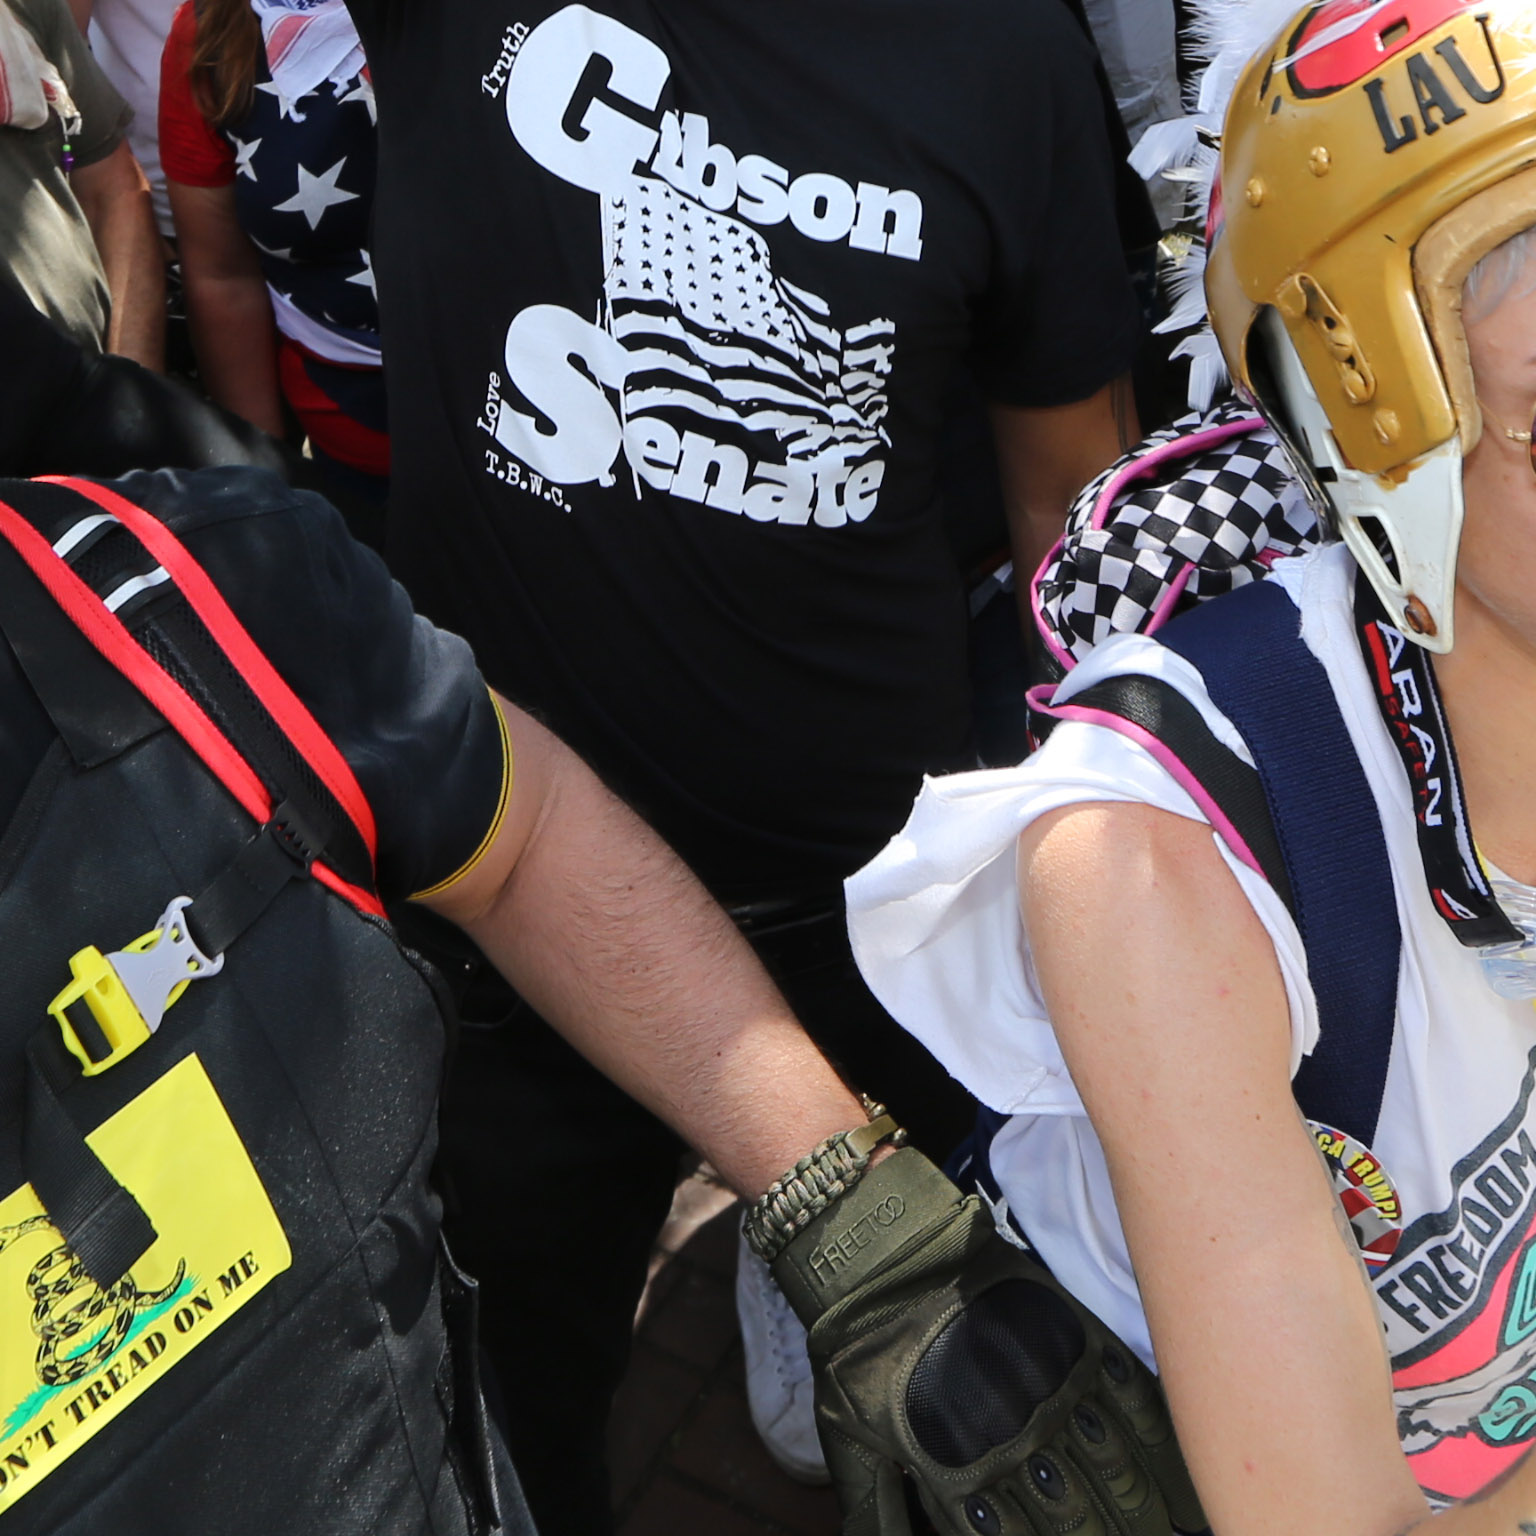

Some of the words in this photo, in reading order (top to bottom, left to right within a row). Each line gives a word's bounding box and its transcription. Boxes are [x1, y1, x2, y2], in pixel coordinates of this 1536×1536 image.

[481, 21, 530, 99] Truth
[1364, 13, 1507, 155] LAU
[506, 3, 923, 261] Gibson
[477, 370, 502, 437] Love
[495, 304, 886, 528] Senate
[1313, 1130, 1346, 1159] CA
[1345, 1150, 1398, 1221] TRUMP!
[808, 1193, 905, 1287] FREETOO
[64, 1331, 167, 1427] TREAD
[173, 1289, 214, 1334] ON
[216, 1250, 260, 1299] ME
